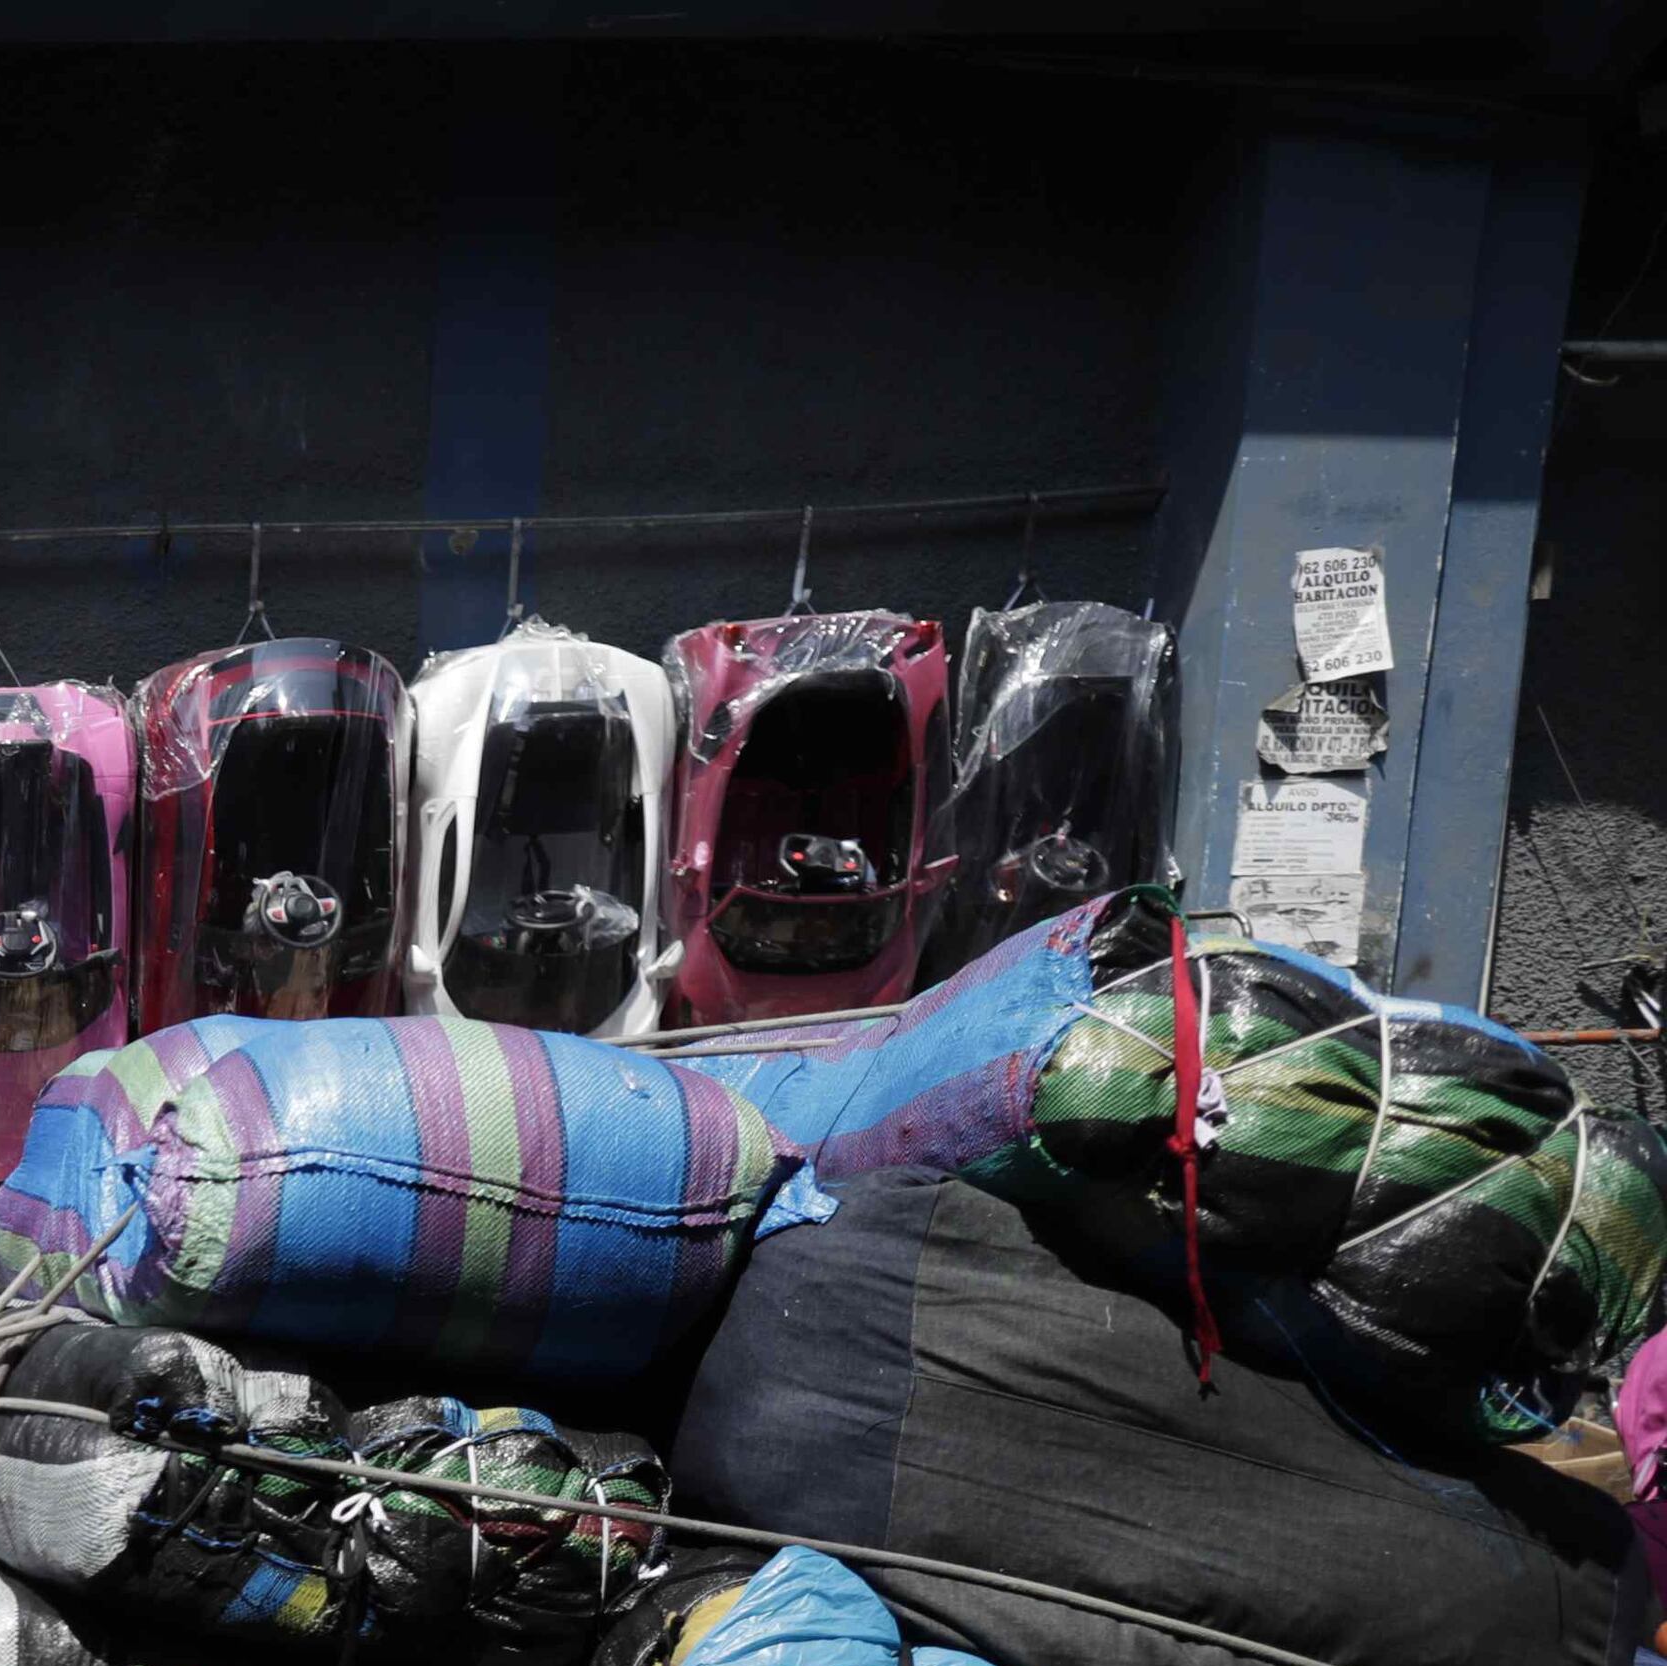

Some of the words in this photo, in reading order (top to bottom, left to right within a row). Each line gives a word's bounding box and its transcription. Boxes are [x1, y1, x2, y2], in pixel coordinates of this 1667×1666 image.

[1324, 559, 1347, 573] 606
[1353, 555, 1376, 569] 230
[1303, 570, 1370, 588] ALQUILO
[1294, 584, 1378, 603] HABITACION
[1324, 657, 1349, 671] 606
[1355, 650, 1382, 665] 230
[1289, 787, 1318, 797] AVISO
[1248, 802, 1307, 811] ALQUILO
